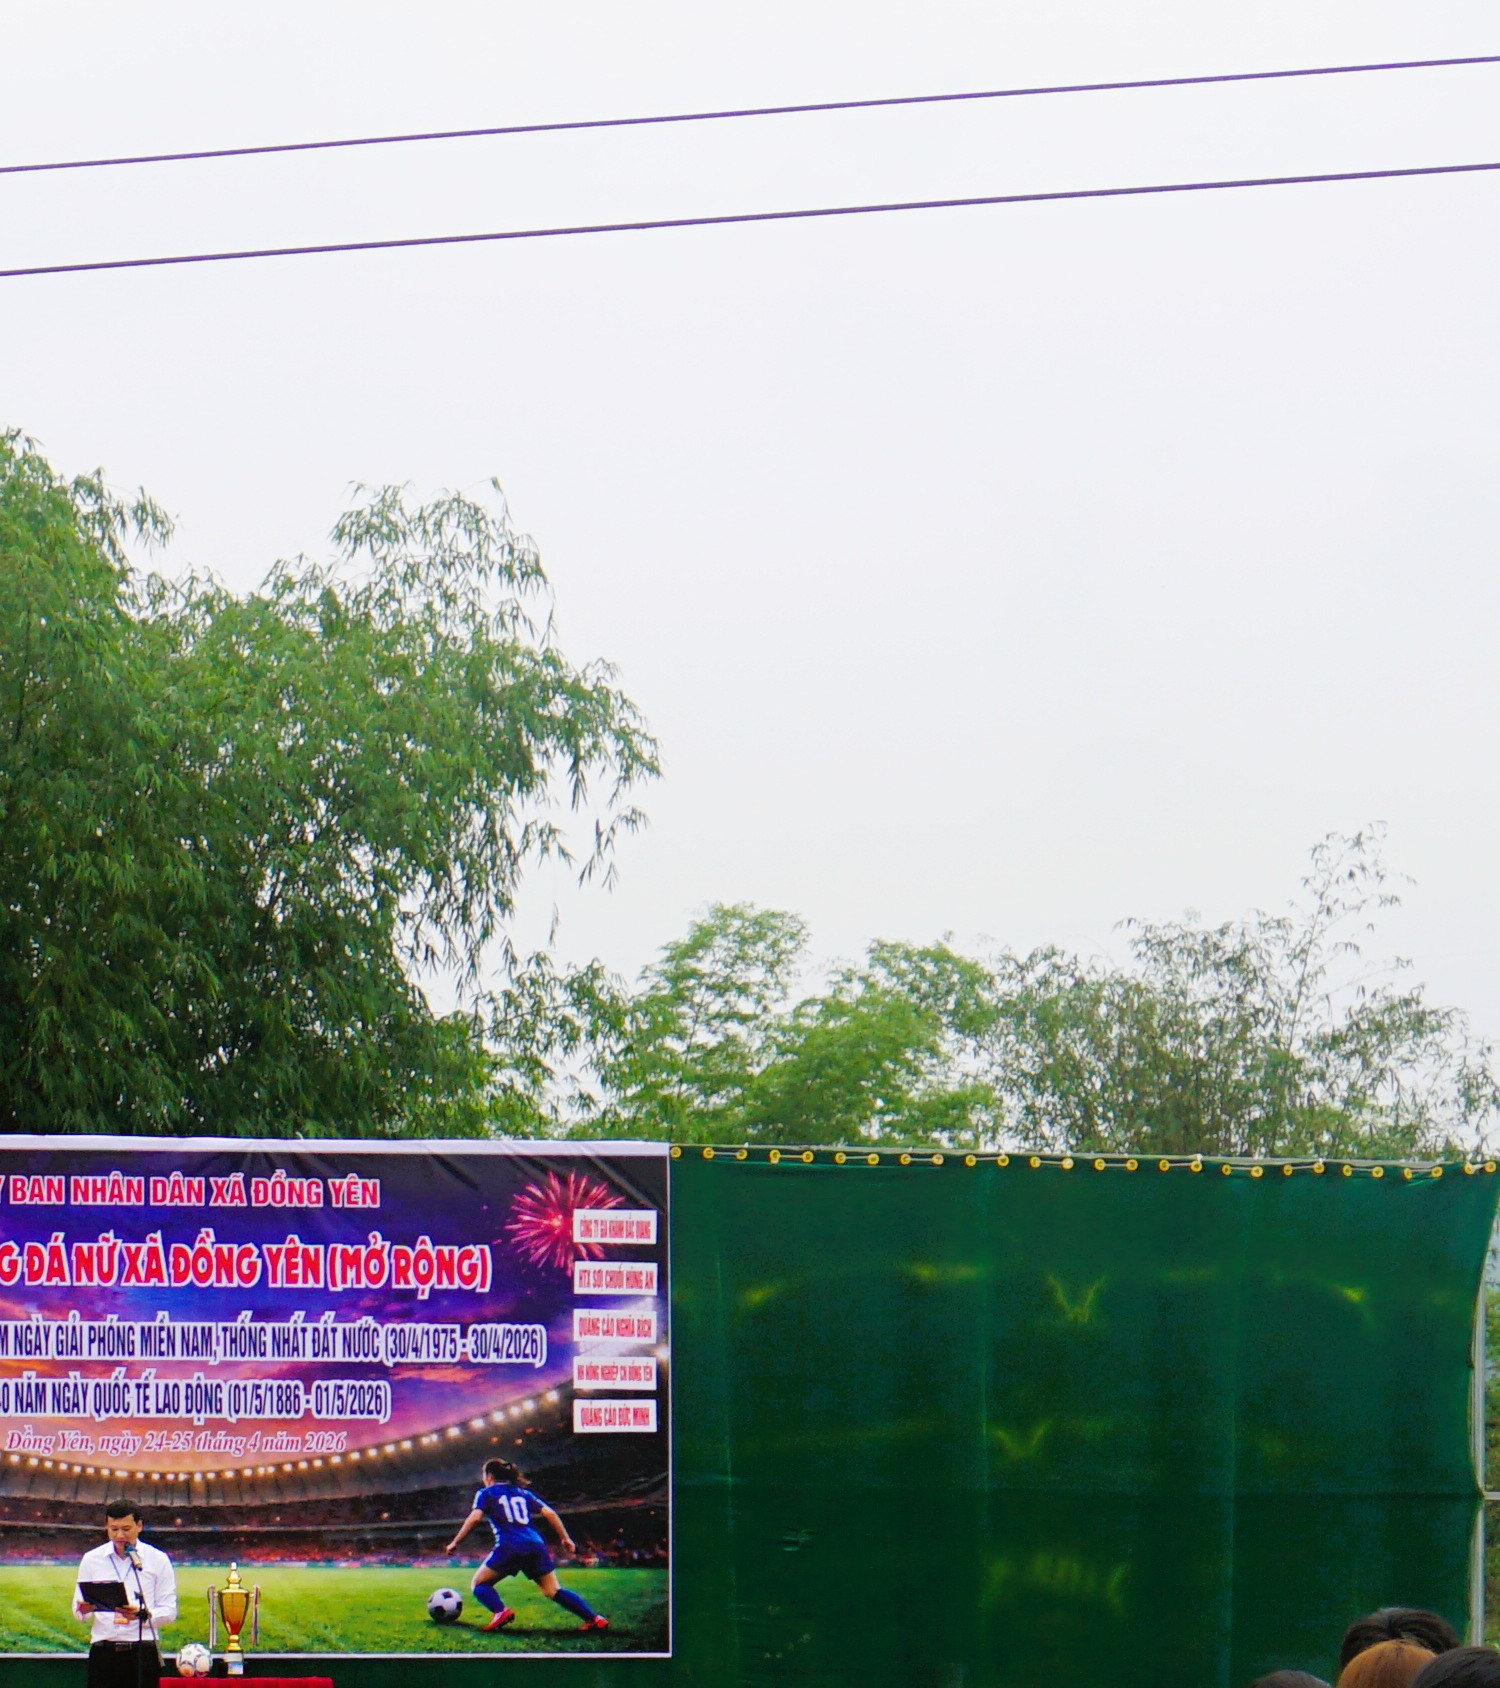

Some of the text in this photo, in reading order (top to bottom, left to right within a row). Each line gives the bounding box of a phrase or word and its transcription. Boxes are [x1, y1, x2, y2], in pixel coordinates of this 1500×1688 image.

[10, 1175, 65, 1205] BAN
[71, 1171, 144, 1205] NHÂN
[150, 1171, 205, 1206] DÂN
[210, 1172, 247, 1206] XÃ
[252, 1169, 324, 1207] ĐỒNG
[328, 1173, 380, 1208] YÊN
[24, 1231, 71, 1287] ĐÁ
[72, 1230, 122, 1287] NỮ
[121, 1230, 169, 1287] XÃ
[170, 1228, 262, 1288] ĐỒNG
[263, 1234, 324, 1288] YÊN
[326, 1231, 391, 1291] (MỞ
[392, 1235, 492, 1299] RỘNG)
[13, 1314, 52, 1358] NGÀY
[55, 1311, 83, 1358] GIẢI
[88, 1314, 135, 1358] PHÓNG
[140, 1311, 176, 1358] MIỀN
[181, 1325, 217, 1363] NAM,
[221, 1311, 267, 1359] THỐNG
[271, 1311, 308, 1359] NHẤT
[312, 1311, 338, 1359] ĐẤT
[342, 1316, 381, 1360] NƯỚC
[384, 1326, 458, 1365] (30/4/1975
[471, 1326, 546, 1366] 30/4/2026)
[14, 1373, 47, 1414] NĂM
[52, 1373, 89, 1415] NGÀY
[93, 1368, 131, 1418] QUỐC
[135, 1369, 153, 1415] TẾ
[155, 1383, 181, 1415] LAO
[184, 1374, 223, 1424] ĐỘNG
[228, 1382, 301, 1420] (01/5/1886
[314, 1382, 390, 1422] 01/5/2026)
[7, 1425, 348, 1457] Đồng Yên, ngày 24-25 tháng 4 năm 2026
[498, 1494, 531, 1525] 10
